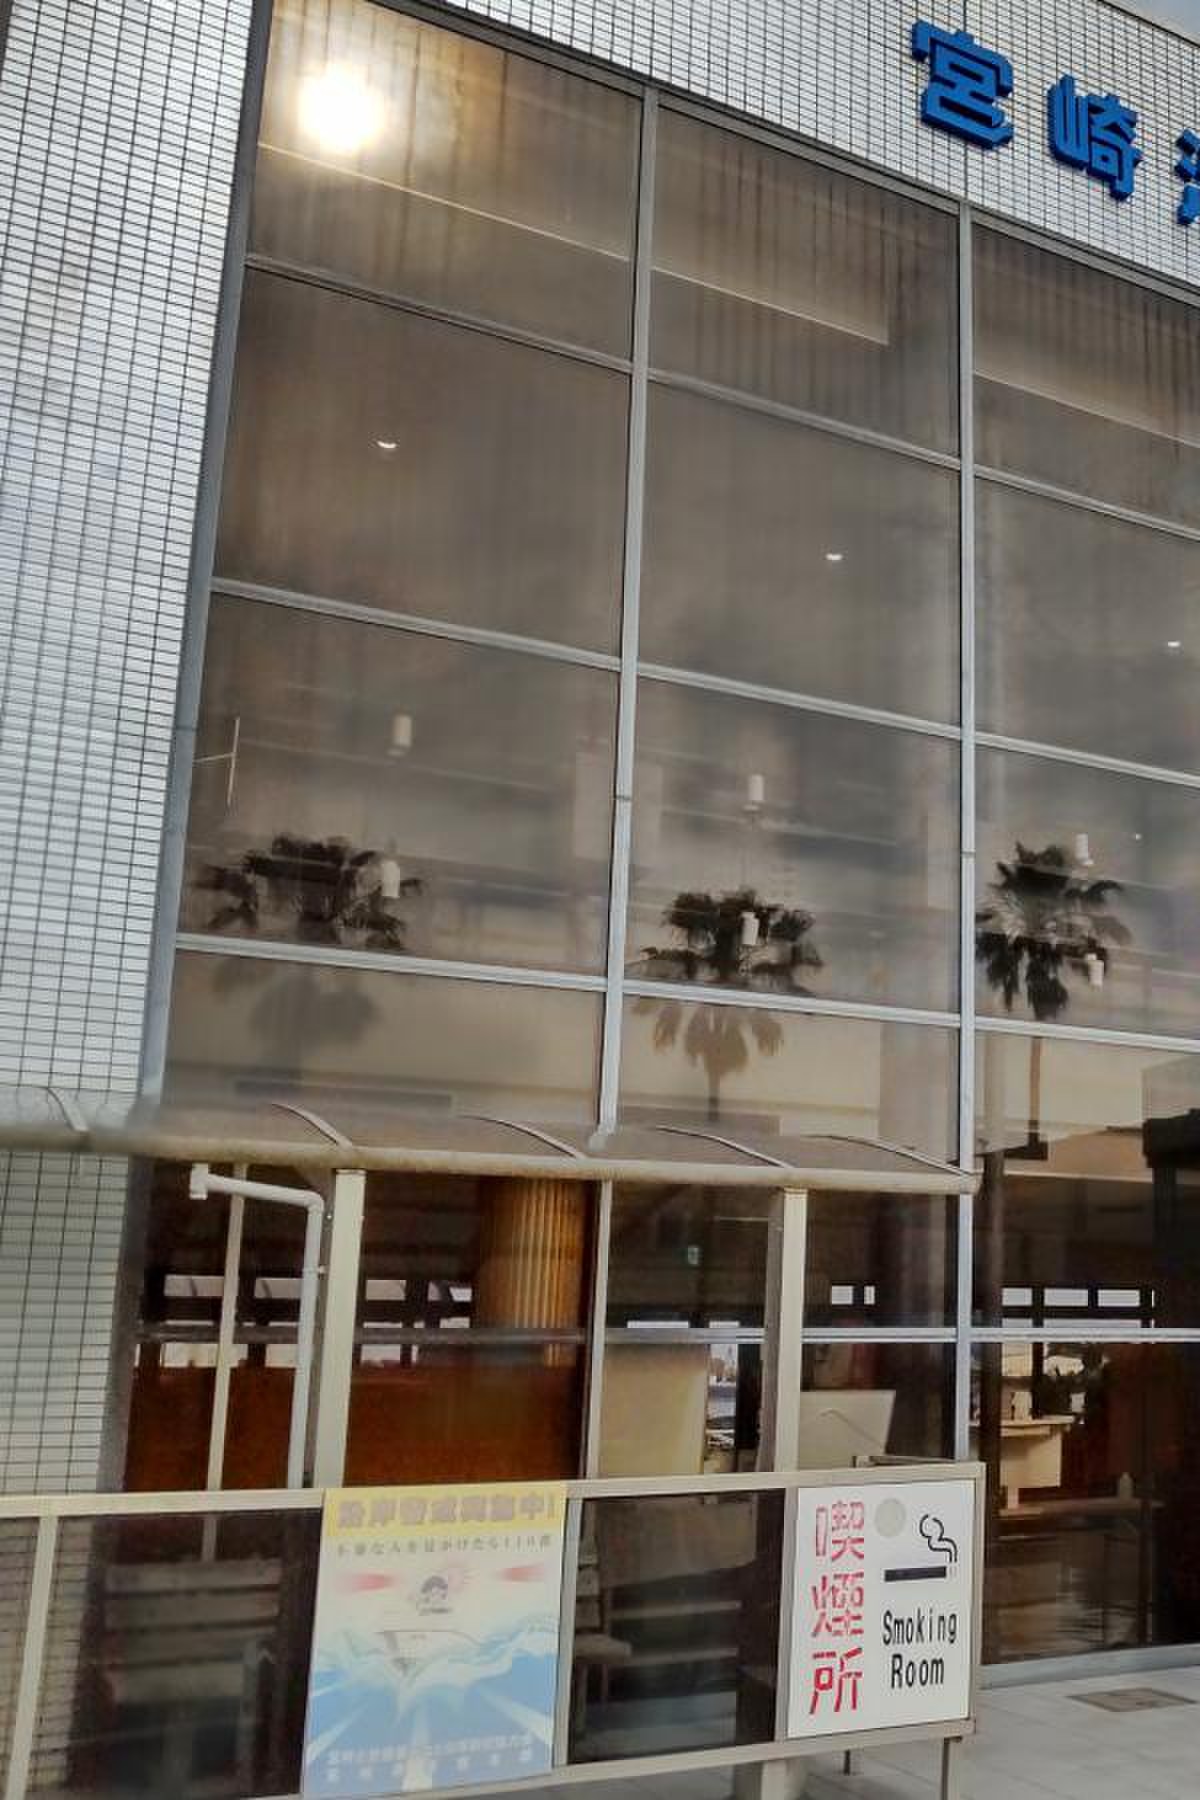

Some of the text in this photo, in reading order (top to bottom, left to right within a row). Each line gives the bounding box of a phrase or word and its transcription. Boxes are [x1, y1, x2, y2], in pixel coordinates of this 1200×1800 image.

[809, 1501, 865, 1714] 喫煙所
[882, 1608, 957, 1647] Smoking
[890, 1654, 944, 1689] Room
